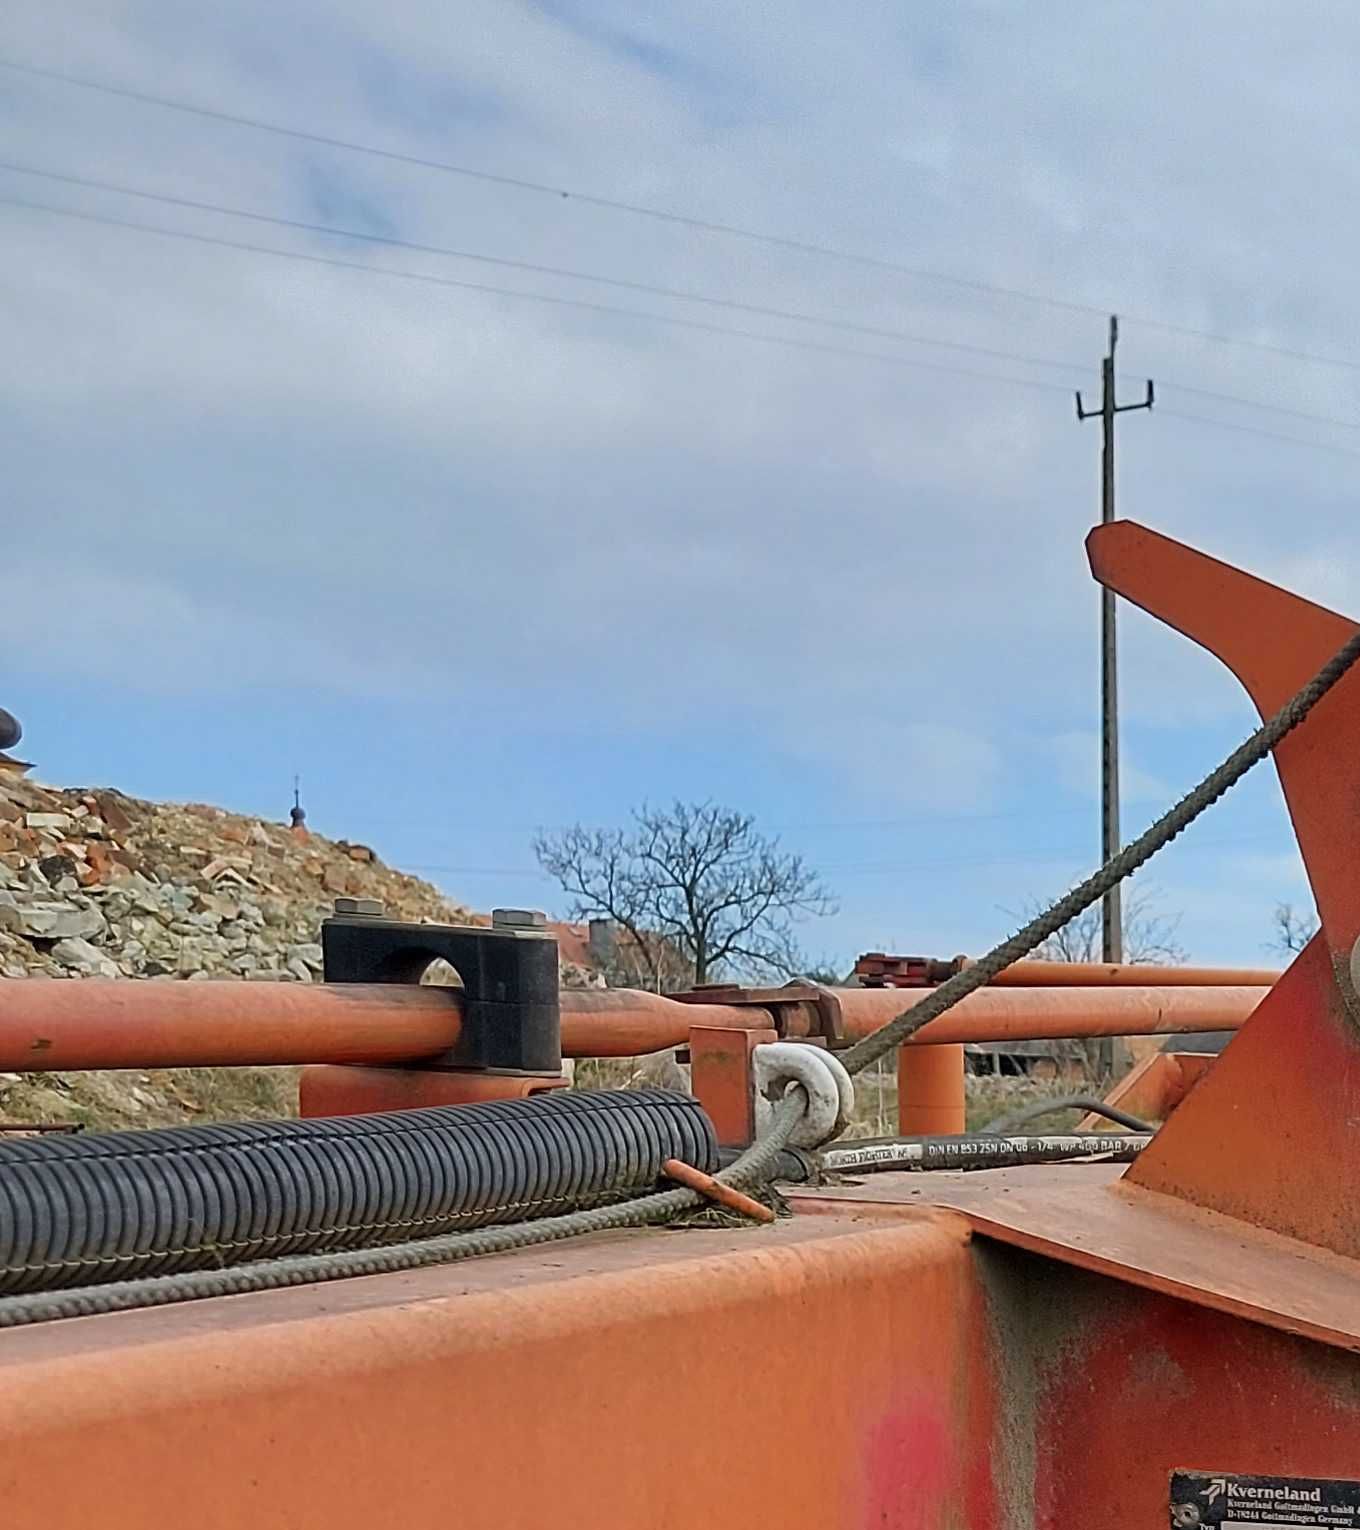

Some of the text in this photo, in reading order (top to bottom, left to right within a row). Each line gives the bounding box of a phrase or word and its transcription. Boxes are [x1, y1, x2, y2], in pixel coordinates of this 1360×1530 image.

[928, 1143, 945, 1155] DIN
[946, 1143, 959, 1155] EN
[1100, 1139, 1122, 1152] BAR
[1227, 1483, 1321, 1502] Kverneland
[1227, 1498, 1273, 1510] Kverneland
[1330, 1504, 1355, 1515] GmbH
[1317, 1514, 1353, 1527] Germany
